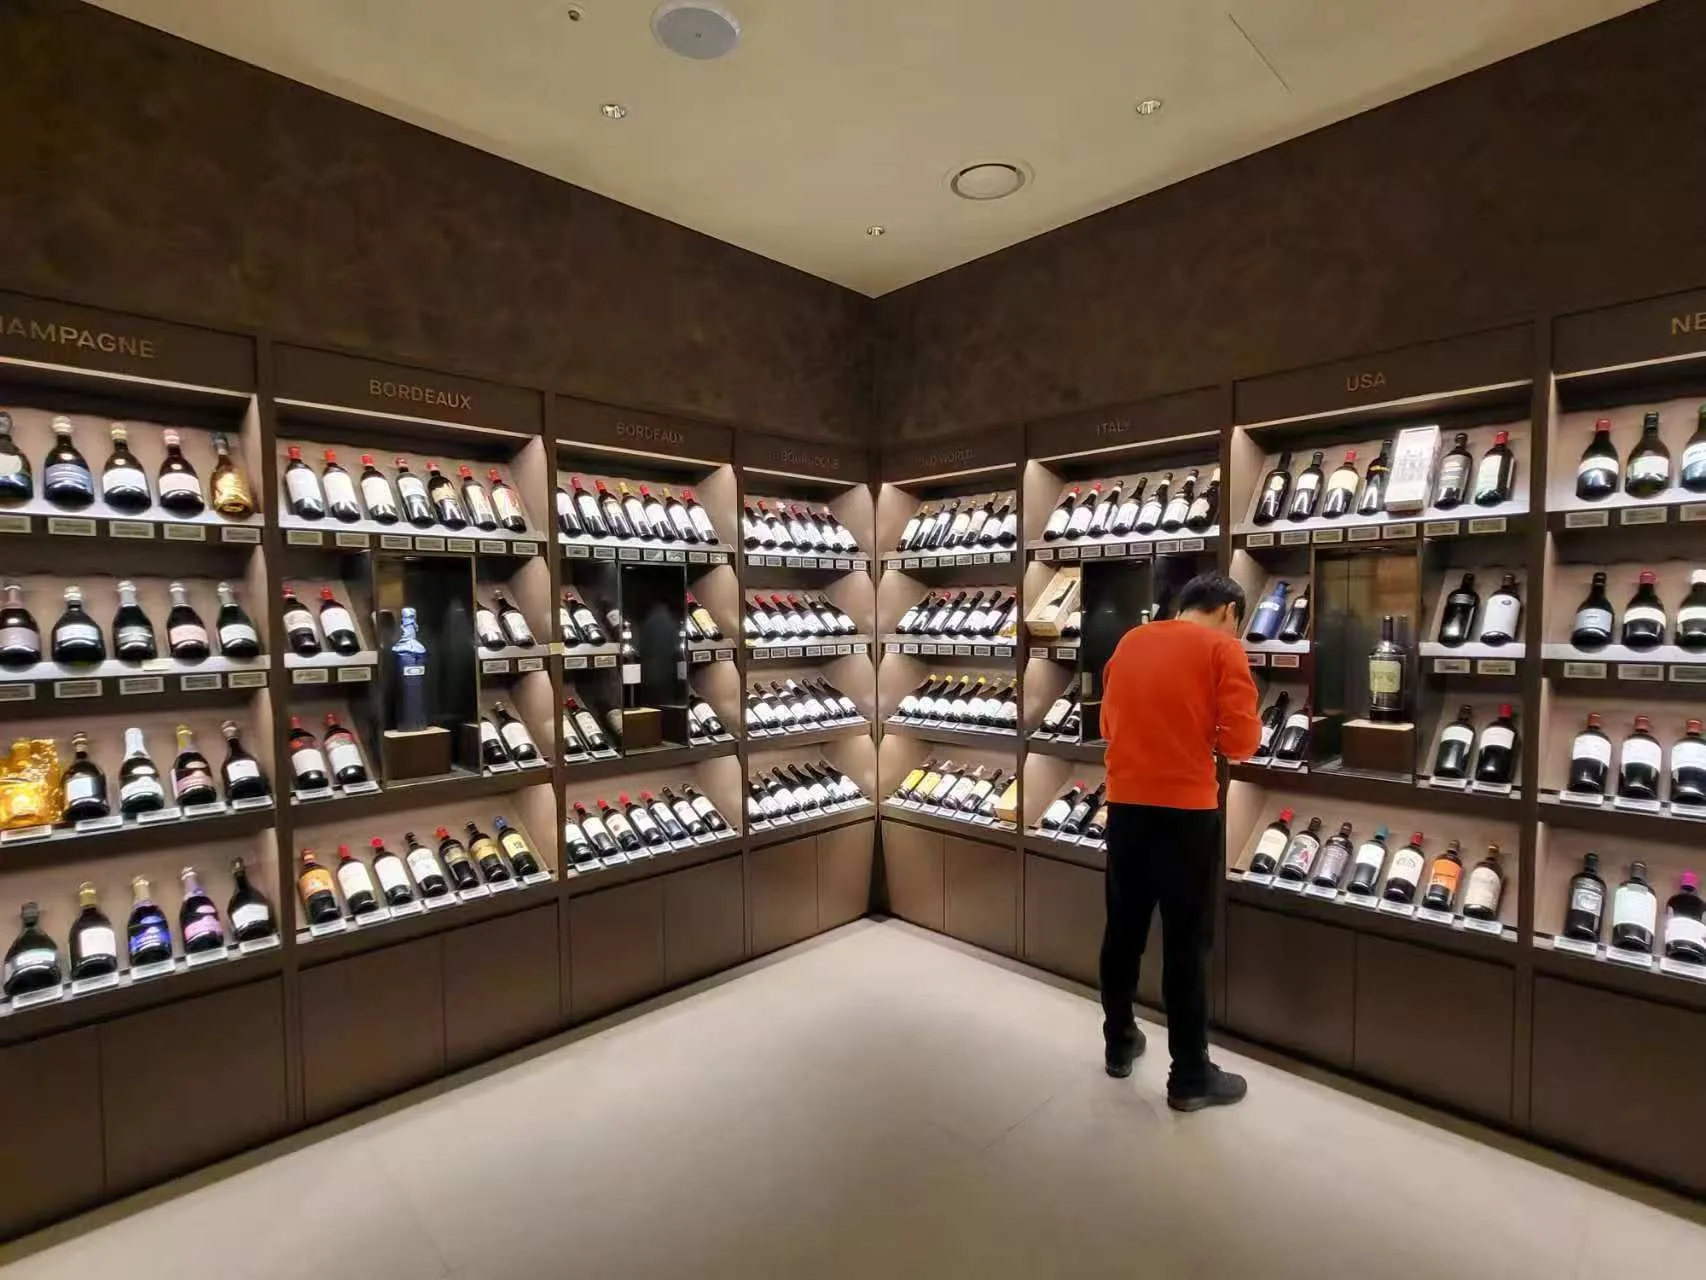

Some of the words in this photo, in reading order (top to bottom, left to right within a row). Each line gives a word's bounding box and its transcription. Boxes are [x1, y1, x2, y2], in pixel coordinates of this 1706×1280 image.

[0, 314, 155, 359] AMPAGNE
[1346, 372, 1386, 393] USA
[369, 378, 472, 410] BORDEAUX
[616, 422, 685, 444] BORDEAUX
[1096, 421, 1131, 436] ITALY
